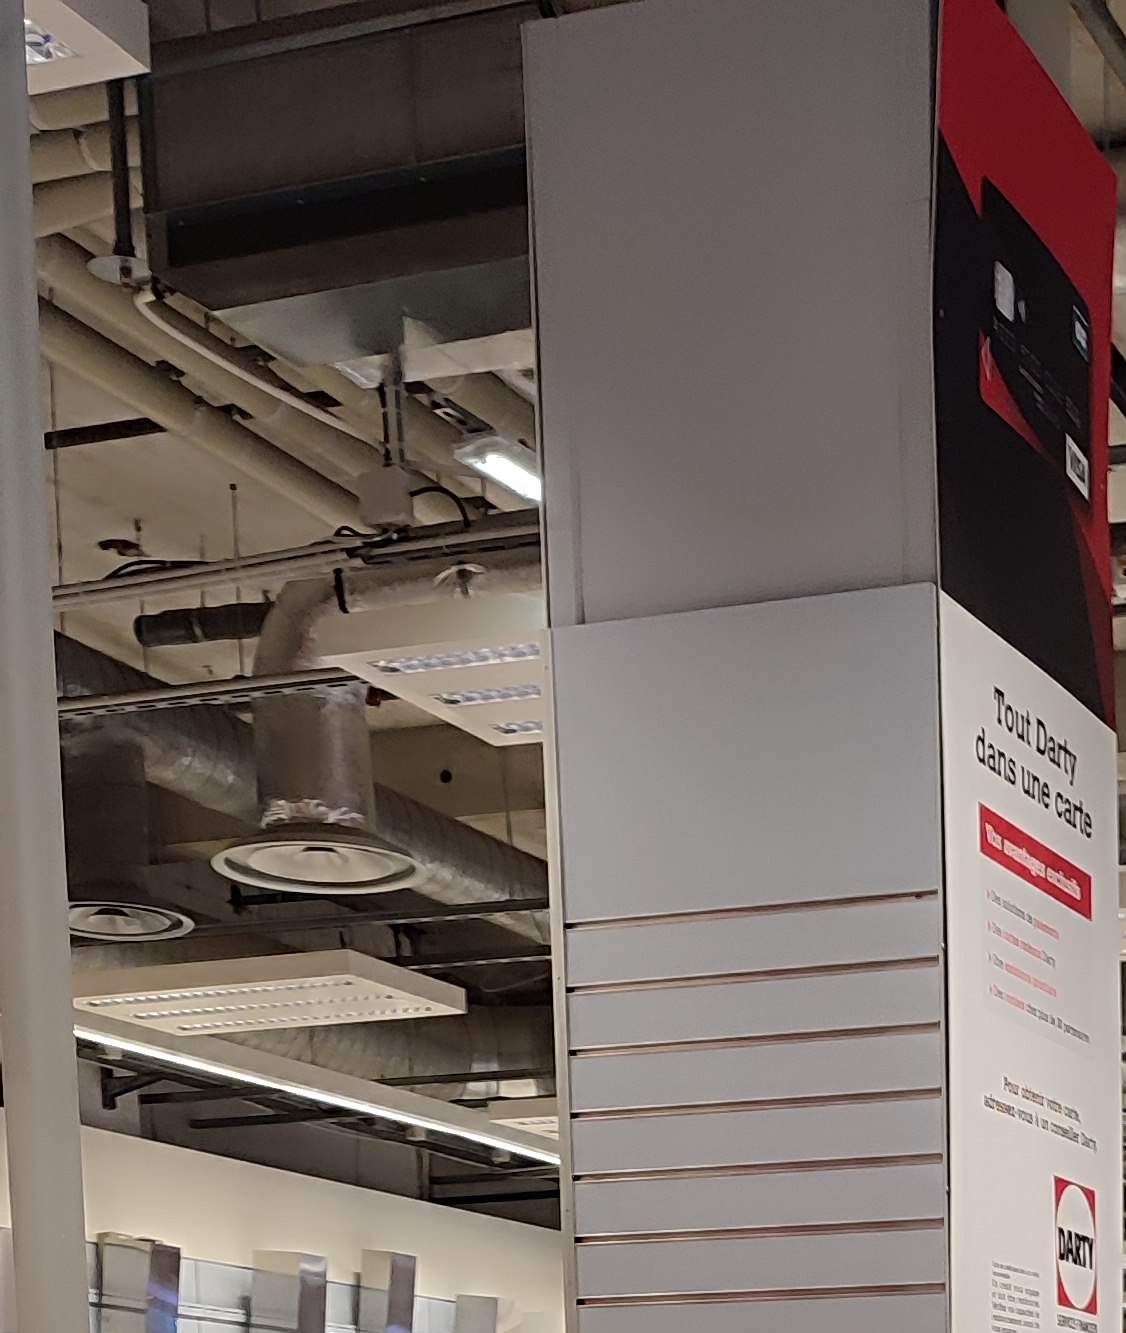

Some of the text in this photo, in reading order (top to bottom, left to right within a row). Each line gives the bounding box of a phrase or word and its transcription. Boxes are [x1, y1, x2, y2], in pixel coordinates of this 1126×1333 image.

[975, 726, 1092, 839] dans une carte
[993, 685, 1077, 786] Tout Darty
[1058, 1226, 1094, 1270] DARTY
